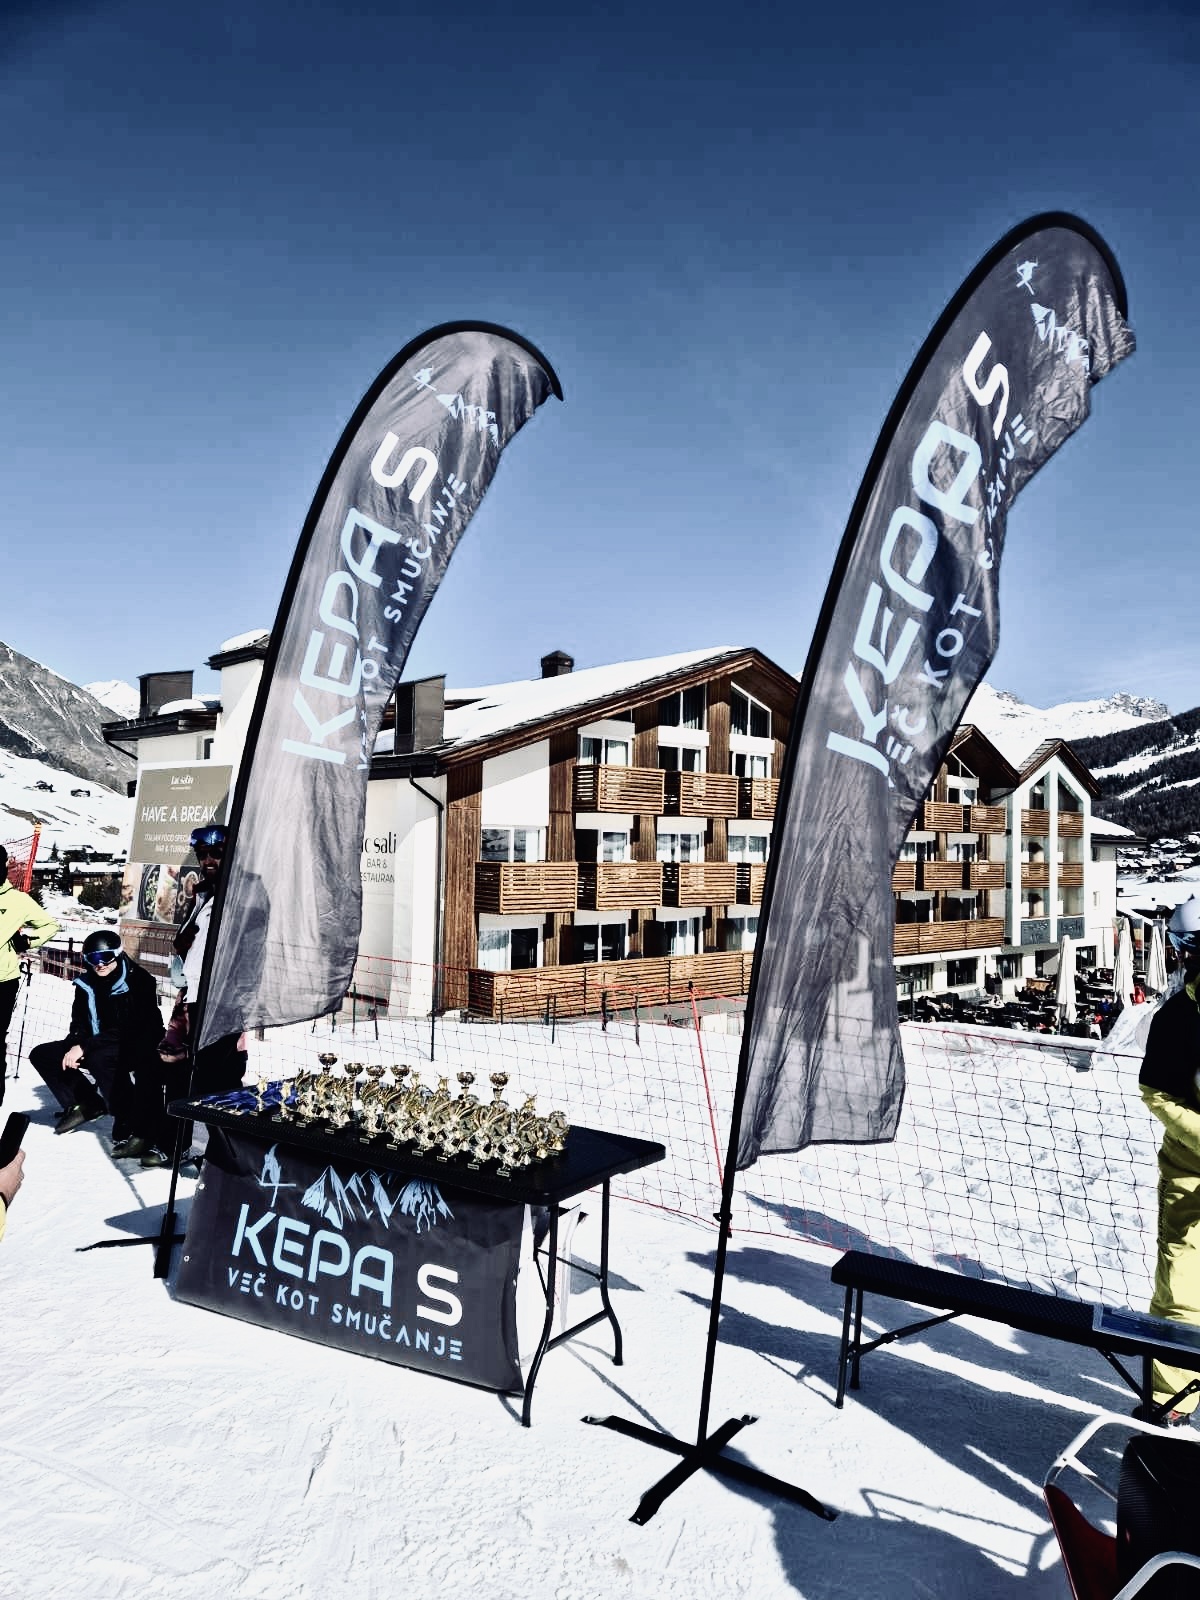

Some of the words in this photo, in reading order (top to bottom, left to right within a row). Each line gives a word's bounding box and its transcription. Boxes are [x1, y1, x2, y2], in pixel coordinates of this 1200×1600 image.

[963, 331, 1010, 441] S
[383, 472, 467, 624] SMUČANJE
[281, 507, 402, 766] KEPA
[371, 431, 439, 504] S
[917, 593, 982, 689] KOT
[141, 805, 168, 822] HAVE
[169, 805, 177, 822] A
[180, 805, 218, 822] BREAK
[373, 831, 397, 854] sali
[366, 858, 381, 868] BAR
[232, 1203, 394, 1308] KEPA
[416, 1263, 463, 1327] S
[228, 1266, 267, 1297] VEČ
[276, 1284, 320, 1316] KOT
[331, 1303, 463, 1361] SMUČANJE
